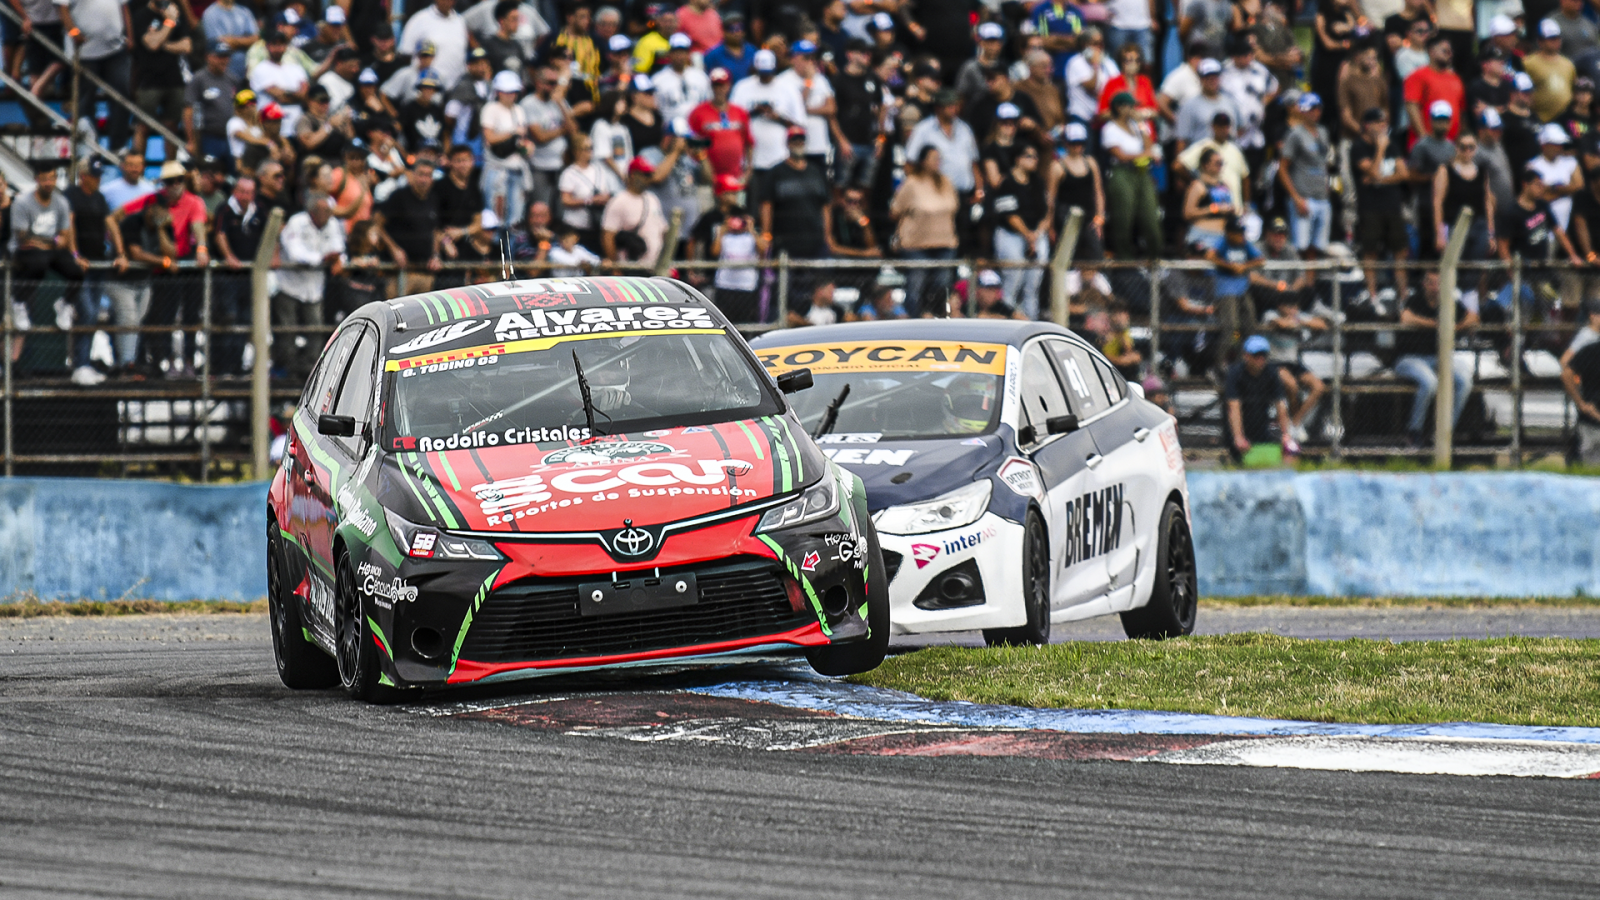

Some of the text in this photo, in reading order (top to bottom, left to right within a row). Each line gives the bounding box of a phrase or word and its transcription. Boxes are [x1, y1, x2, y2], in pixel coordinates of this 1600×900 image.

[494, 306, 711, 333] Alvarez
[495, 319, 714, 342] NEUMATICOS
[420, 358, 476, 374] TODINO
[419, 425, 591, 452] Rodolfo Cristales
[486, 484, 757, 527] Resortes de Suspensión
[1065, 483, 1123, 568] BREMEN
